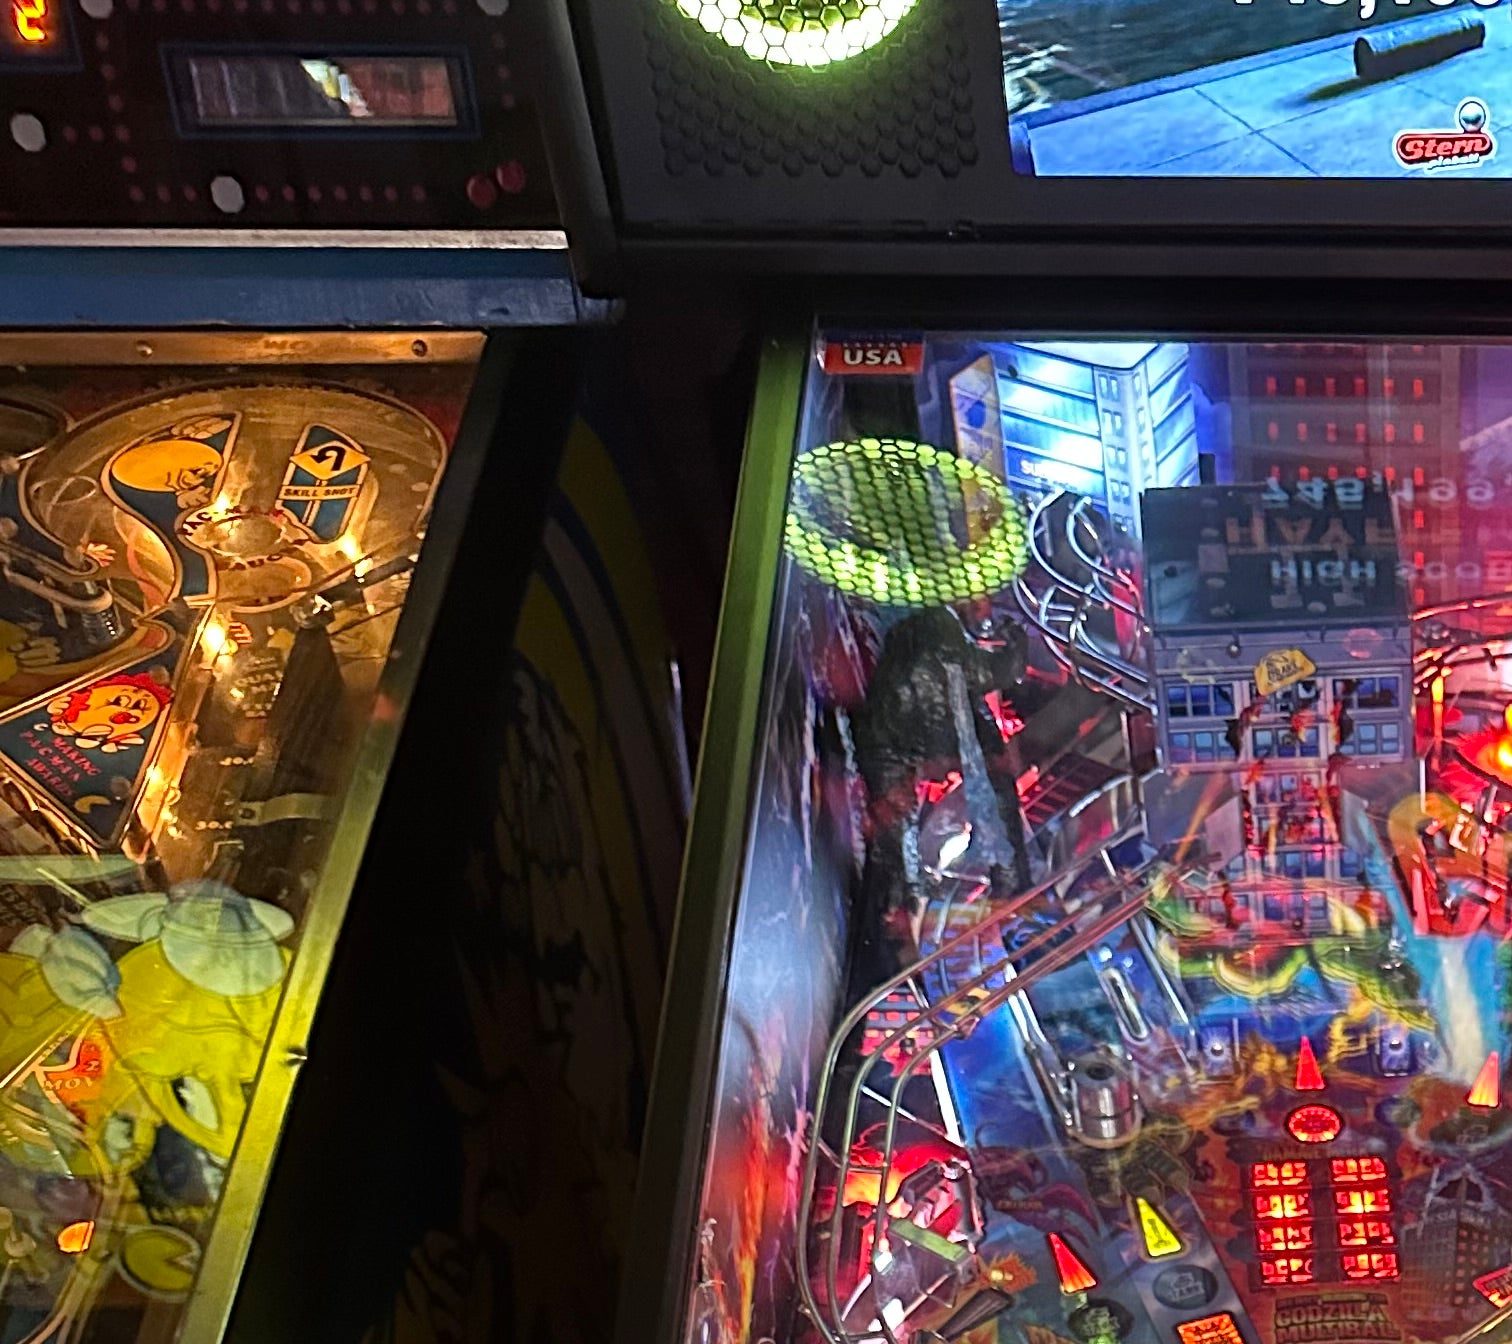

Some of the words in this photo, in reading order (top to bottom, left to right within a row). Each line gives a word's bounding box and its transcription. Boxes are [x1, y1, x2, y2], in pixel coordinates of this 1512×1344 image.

[1405, 138, 1483, 159] Stern
[844, 350, 903, 366] USA
[284, 488, 319, 497] SKILL
[324, 486, 355, 496] SHOT
